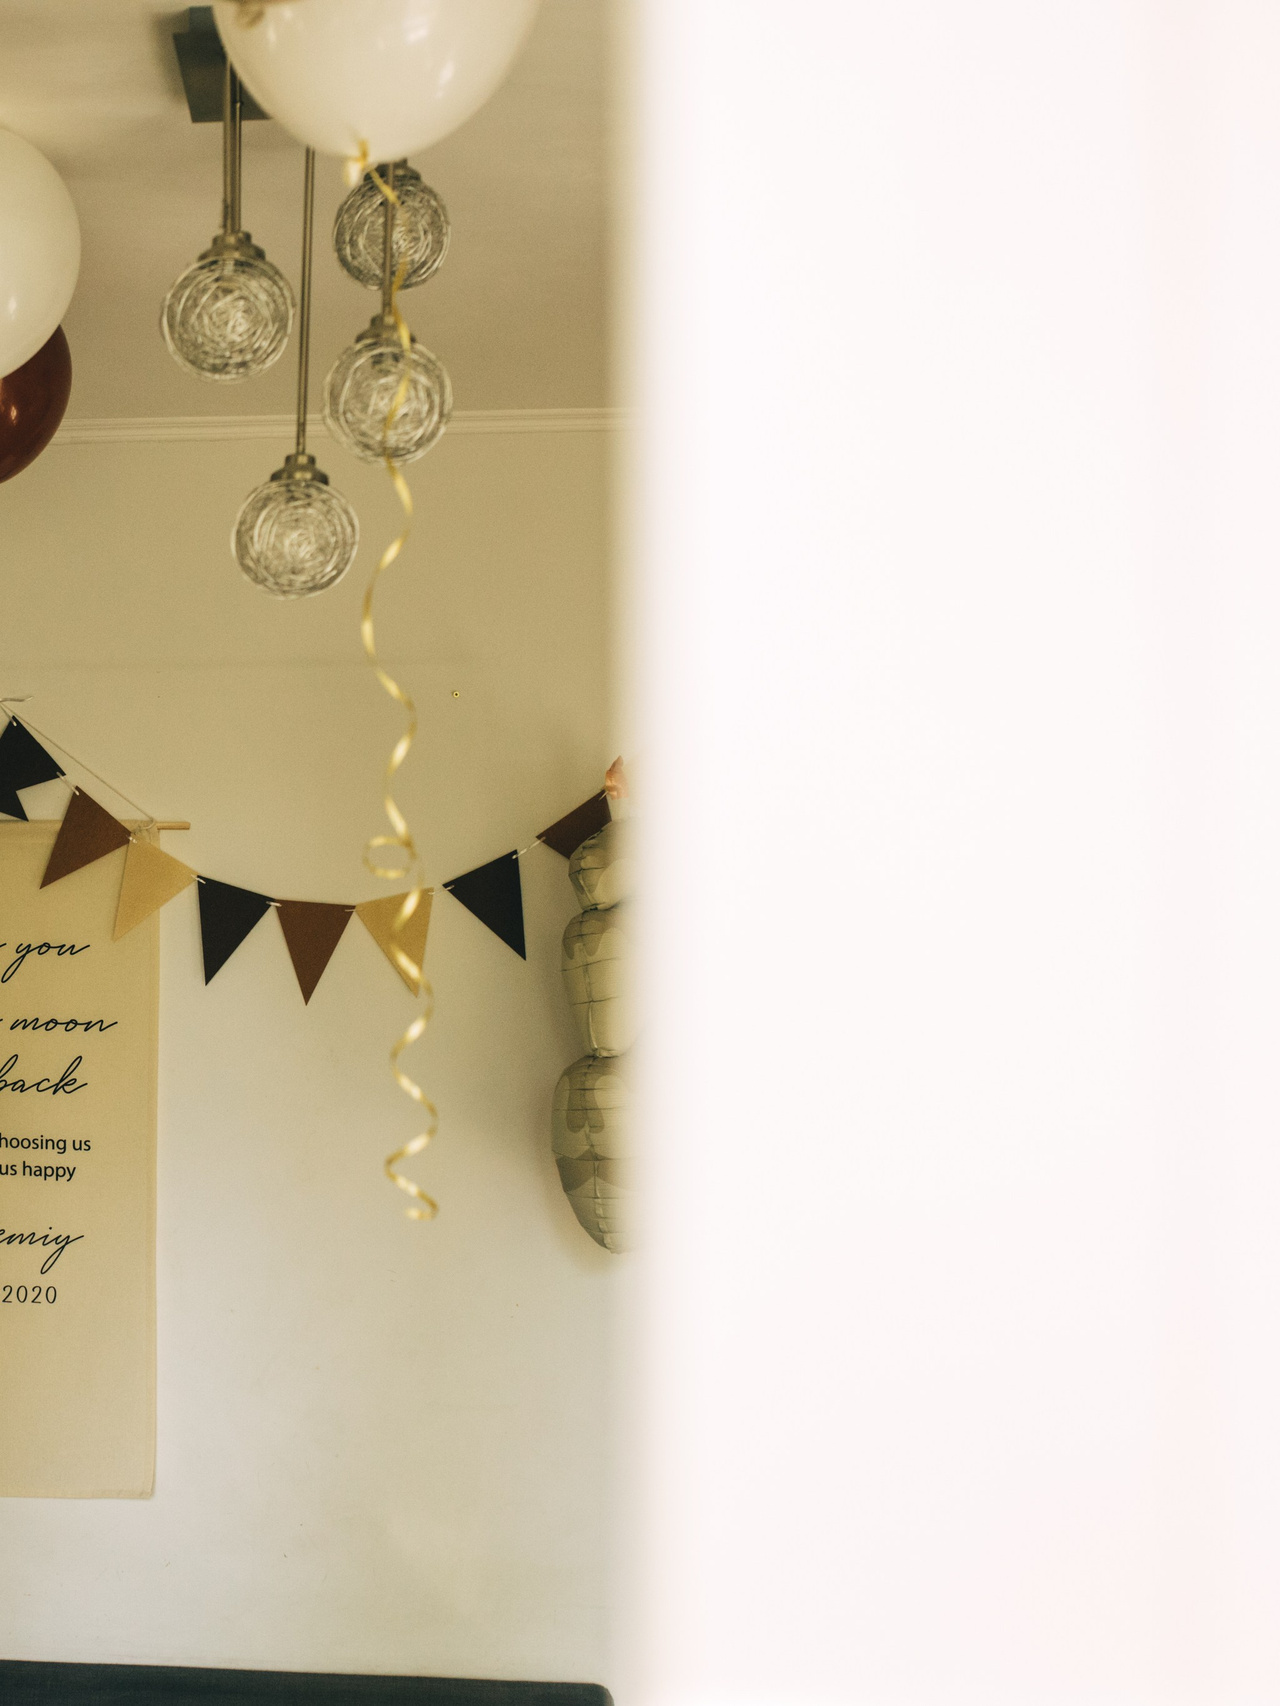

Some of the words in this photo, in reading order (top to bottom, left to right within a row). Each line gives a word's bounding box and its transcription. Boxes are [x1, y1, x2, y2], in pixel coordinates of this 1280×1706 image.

[1, 941, 91, 984] you
[9, 1016, 119, 1033] moon
[72, 1139, 92, 1152] us
[22, 1160, 77, 1183] happy
